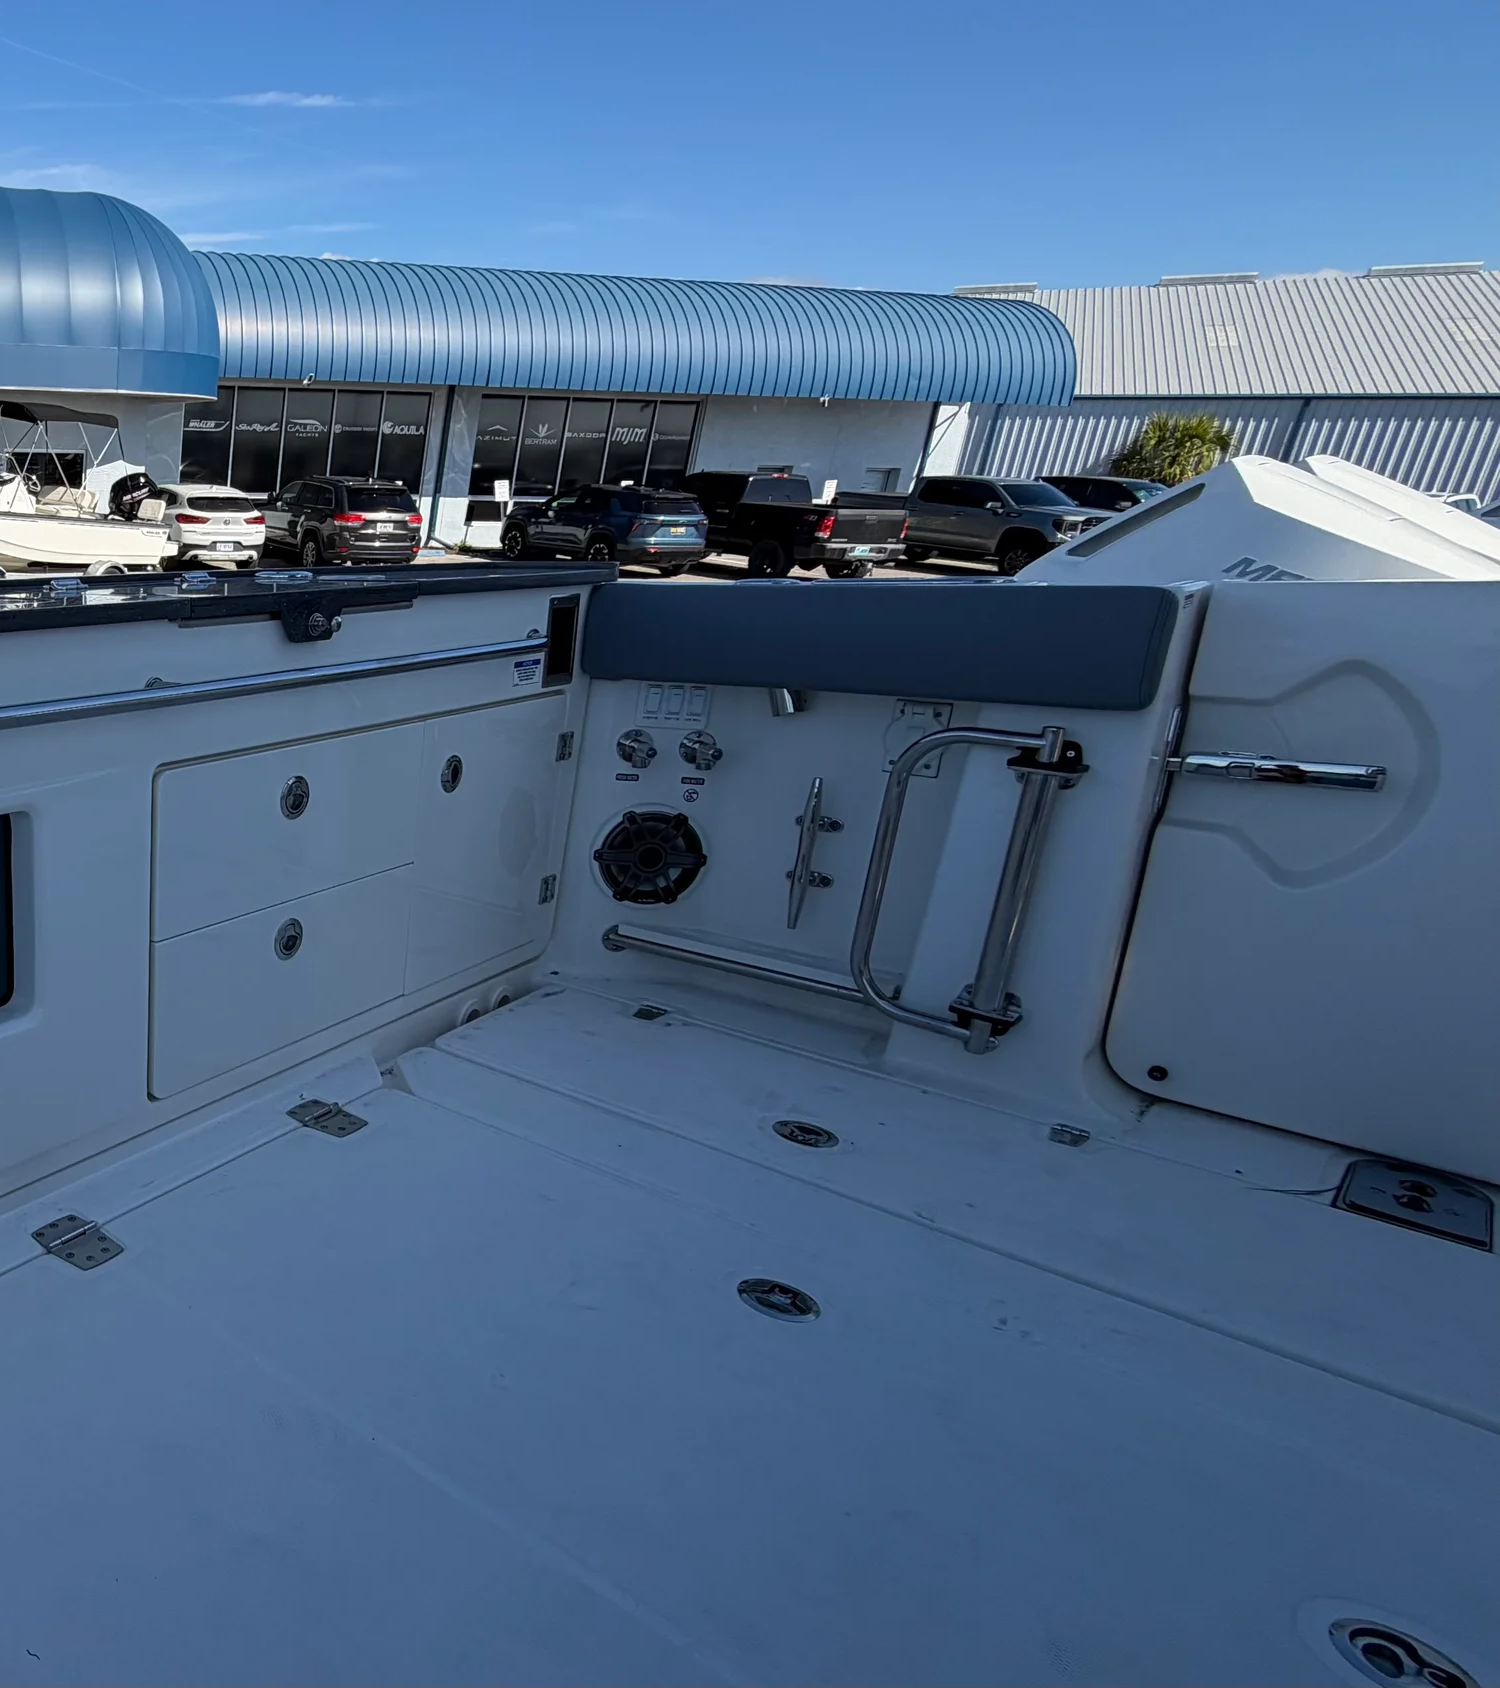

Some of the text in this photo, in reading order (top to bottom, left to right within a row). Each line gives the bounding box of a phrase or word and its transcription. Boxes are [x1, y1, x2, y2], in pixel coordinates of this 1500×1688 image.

[287, 423, 328, 433] GALEON
[393, 425, 425, 435] AQUILA
[524, 437, 558, 445] BERTRAM
